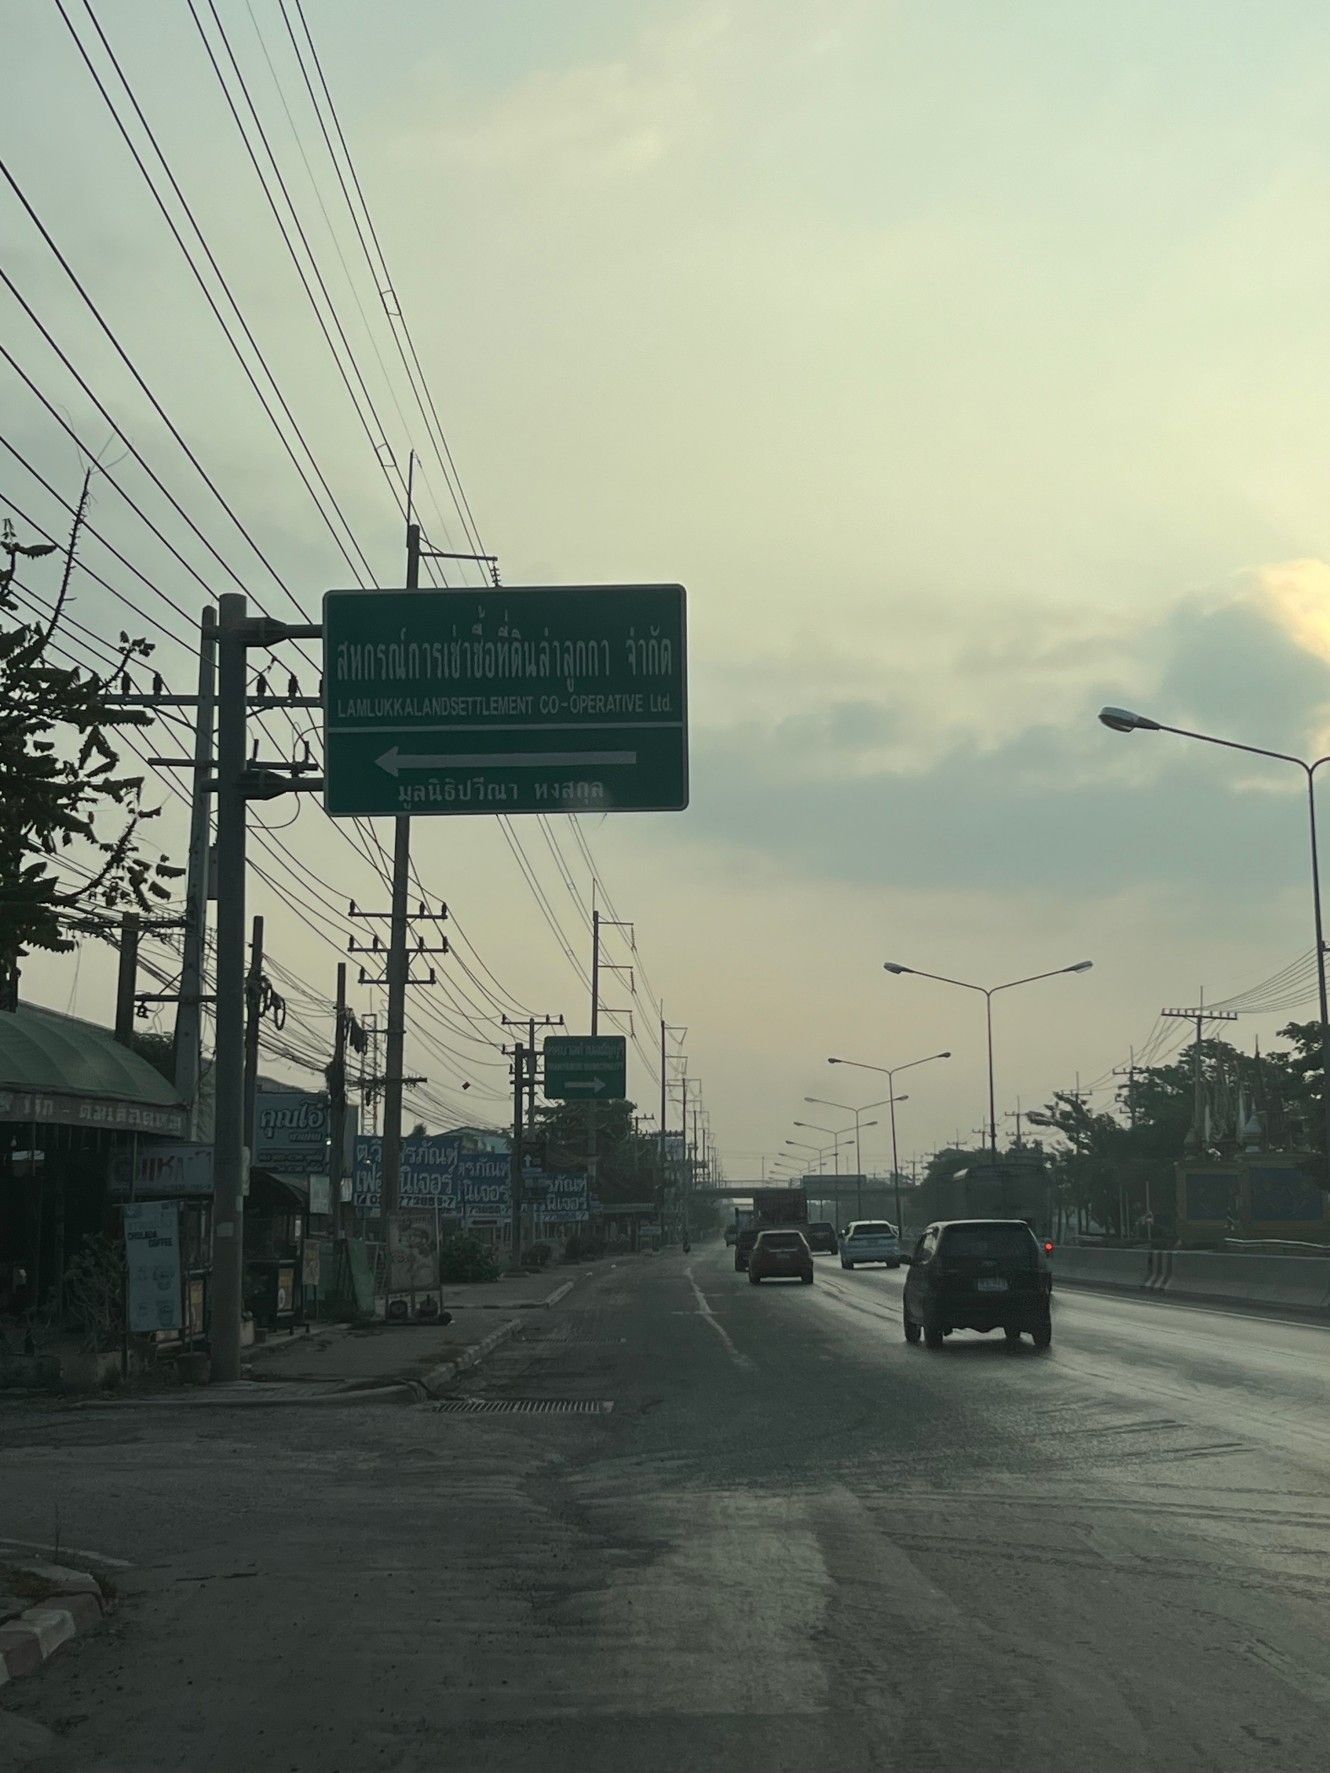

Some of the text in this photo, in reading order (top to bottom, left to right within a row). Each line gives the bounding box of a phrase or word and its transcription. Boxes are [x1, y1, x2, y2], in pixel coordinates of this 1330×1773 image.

[337, 696, 533, 719] LAMLUKKALANDSETTLEMENT
[539, 694, 644, 716] CO-OPERATIVE
[397, 777, 605, 810] มูลนิธิปวีณา หงสกุล
